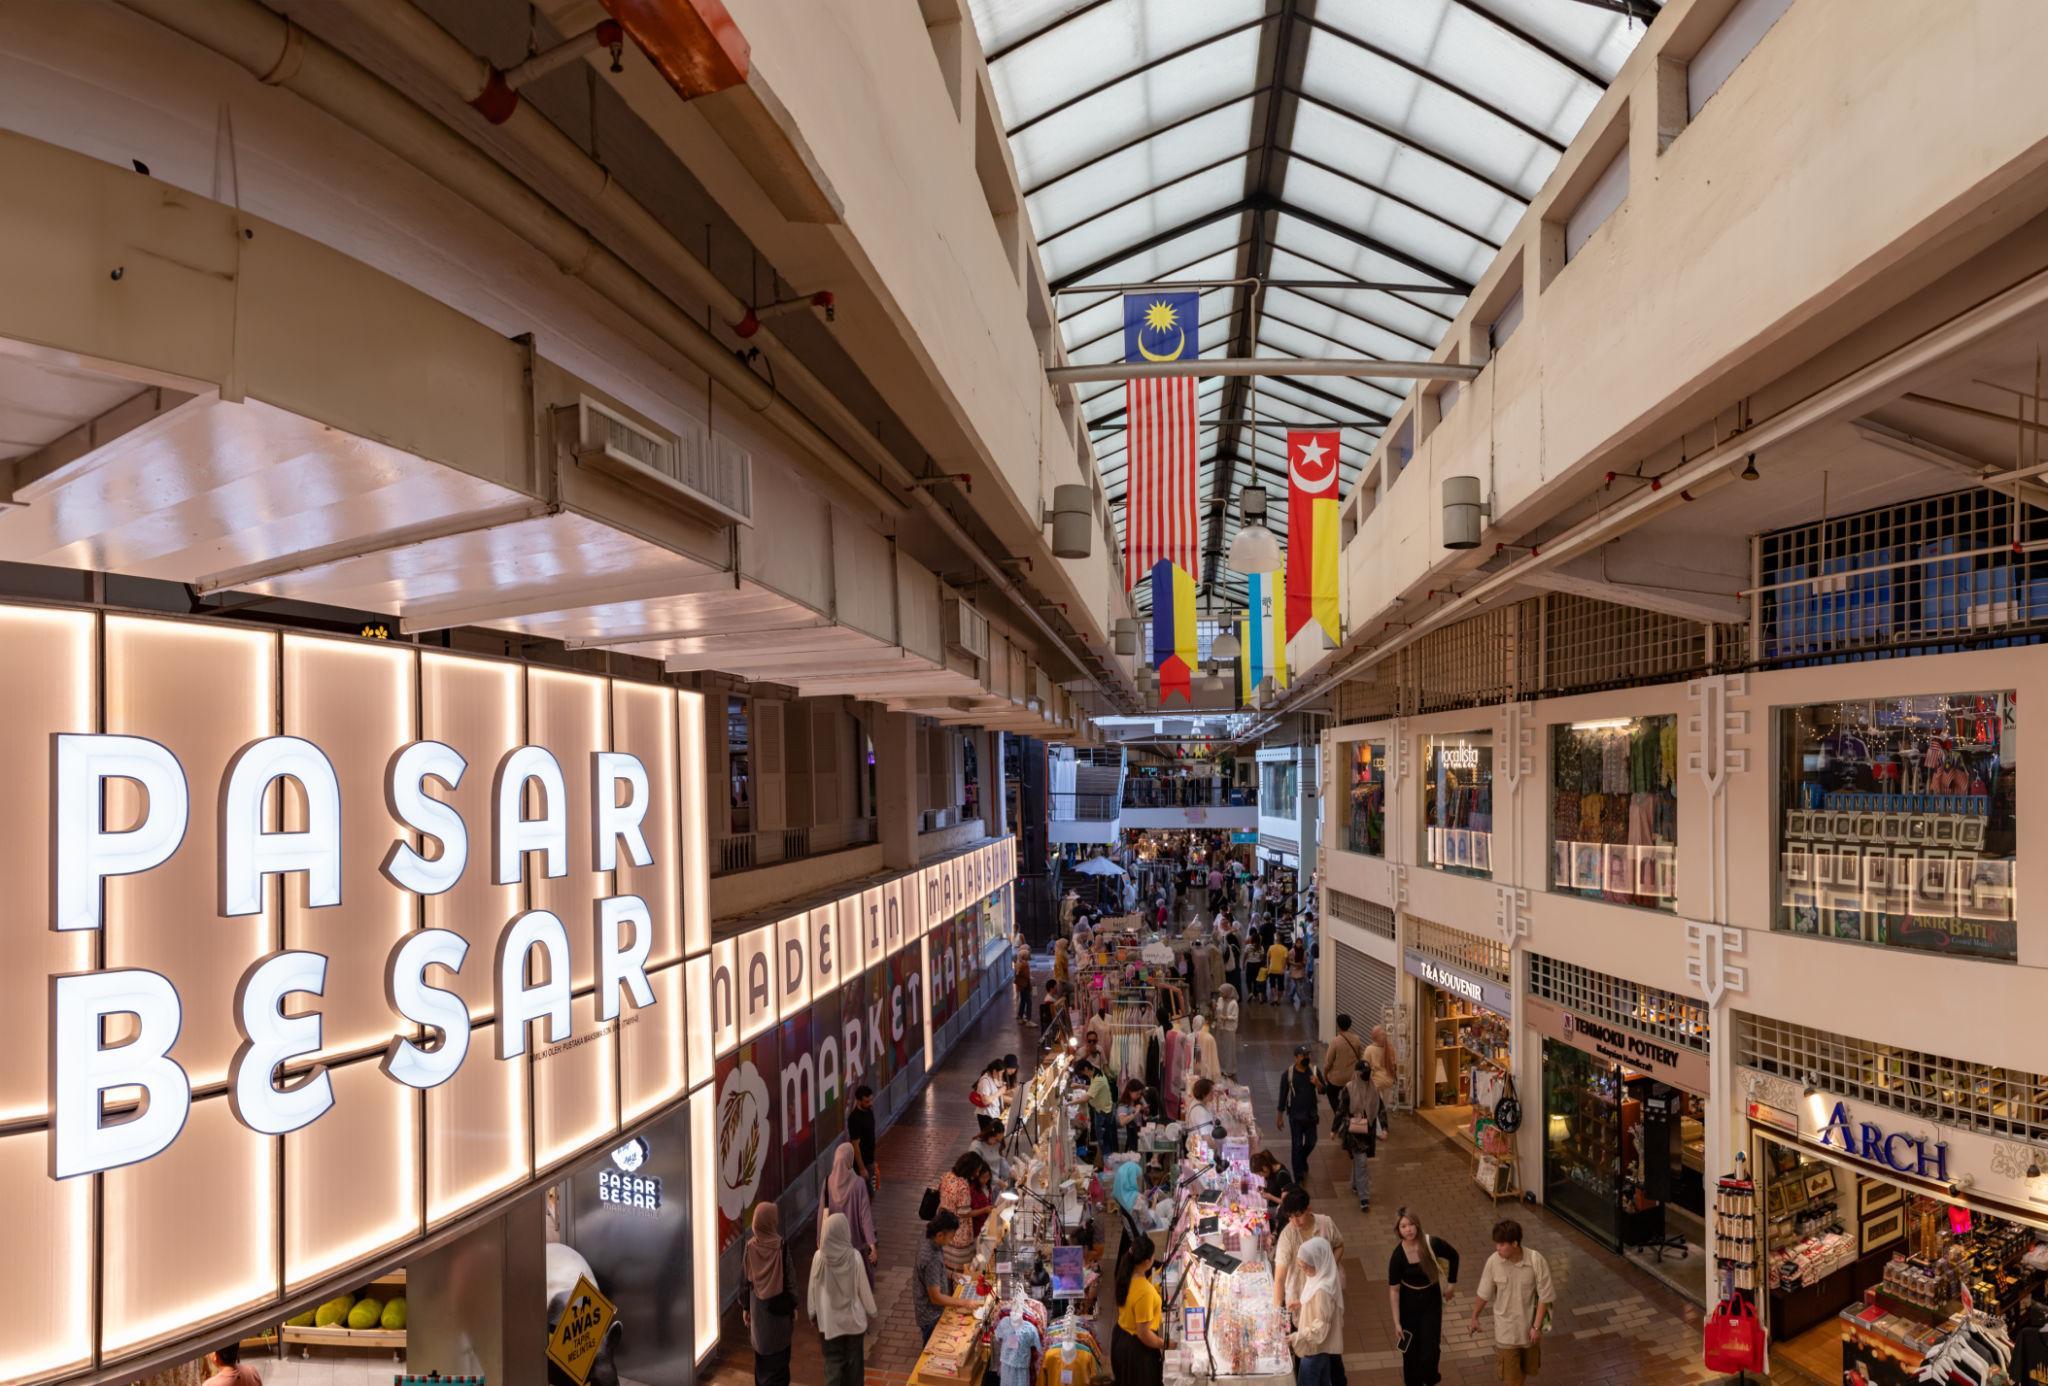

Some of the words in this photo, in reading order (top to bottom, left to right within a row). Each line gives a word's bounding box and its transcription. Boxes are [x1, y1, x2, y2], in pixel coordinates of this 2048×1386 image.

[1441, 739, 1478, 763] localista
[49, 733, 655, 931] PASAR
[929, 848, 1008, 916] MALAYSIA
[1421, 962, 1438, 983] T&A
[1439, 970, 1482, 1001] SOUVENIR
[48, 895, 657, 1181] BESAR
[1575, 1017, 1625, 1048] TENMOKU
[1628, 1037, 1679, 1068] POTTERY
[781, 972, 921, 1146] MARKET
[599, 1172, 656, 1195] PASAR
[599, 1186, 657, 1210] BESAR
[562, 1307, 601, 1345] AWAS
[567, 1338, 596, 1362] MELINTAS
